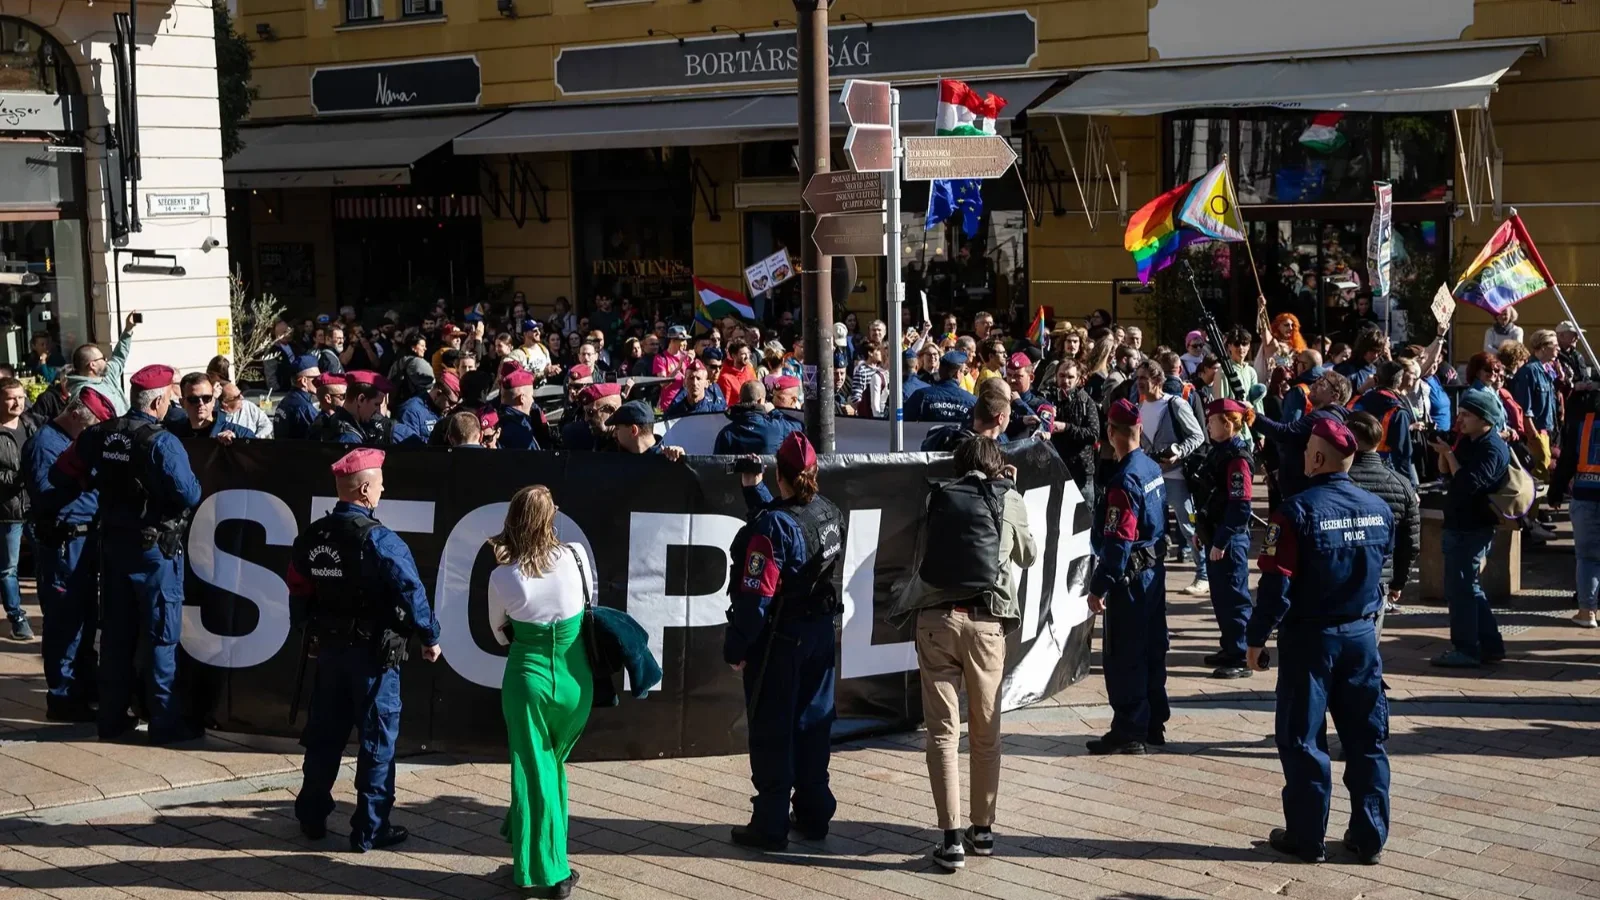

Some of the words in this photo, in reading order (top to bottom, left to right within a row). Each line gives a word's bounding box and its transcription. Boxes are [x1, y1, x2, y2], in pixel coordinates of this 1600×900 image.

[0, 98, 41, 126] eyser
[909, 149, 951, 158] TOURINFORM
[909, 159, 951, 167] TOURINFORM
[592, 259, 630, 275] FINE
[1319, 515, 1353, 531] KÉSZENLÉTI
[1343, 530, 1366, 542] POLICE
[309, 545, 341, 563] KÉSZENLÉTI
[311, 566, 343, 577] RENDŐRSÉG
